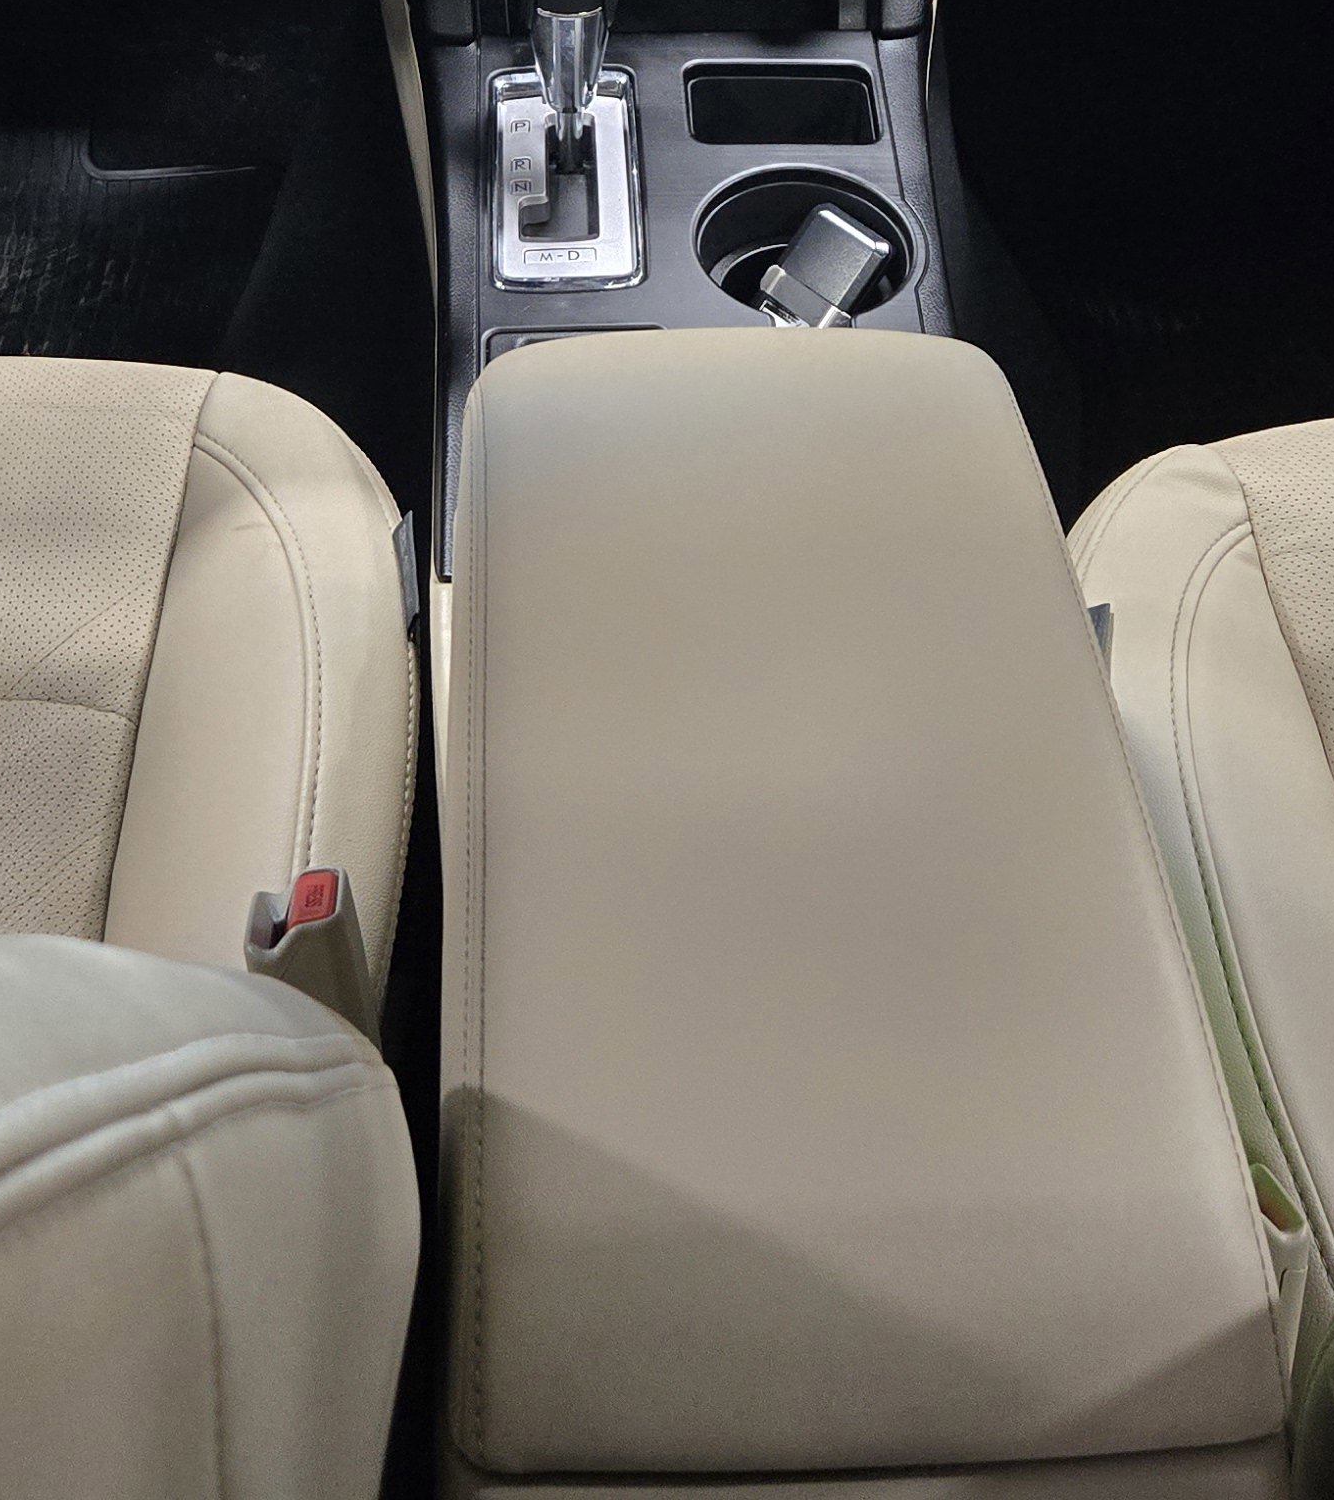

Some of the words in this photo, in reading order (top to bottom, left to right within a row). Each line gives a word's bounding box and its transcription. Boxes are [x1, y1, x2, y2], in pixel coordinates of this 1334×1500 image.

[514, 122, 527, 132] P
[514, 160, 526, 170] R
[514, 182, 528, 192] N
